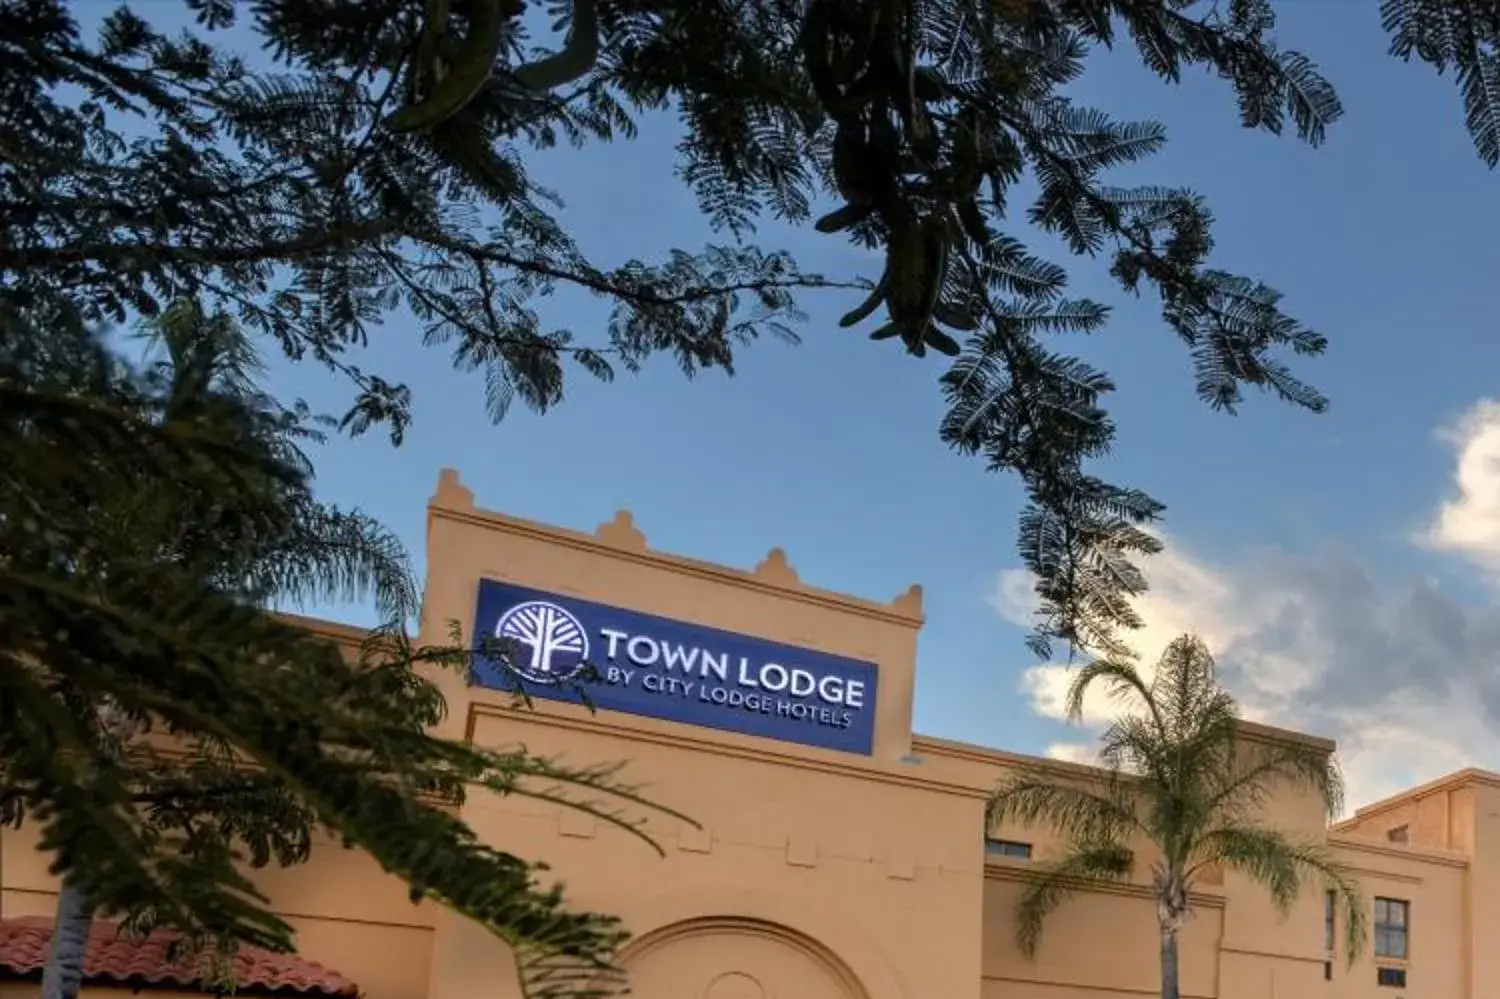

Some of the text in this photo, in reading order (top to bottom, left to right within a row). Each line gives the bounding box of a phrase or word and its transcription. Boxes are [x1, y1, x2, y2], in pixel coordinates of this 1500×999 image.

[600, 628, 865, 707] TOWN LODGE
[607, 667, 851, 728] BY CITY LODGE HOTELS
